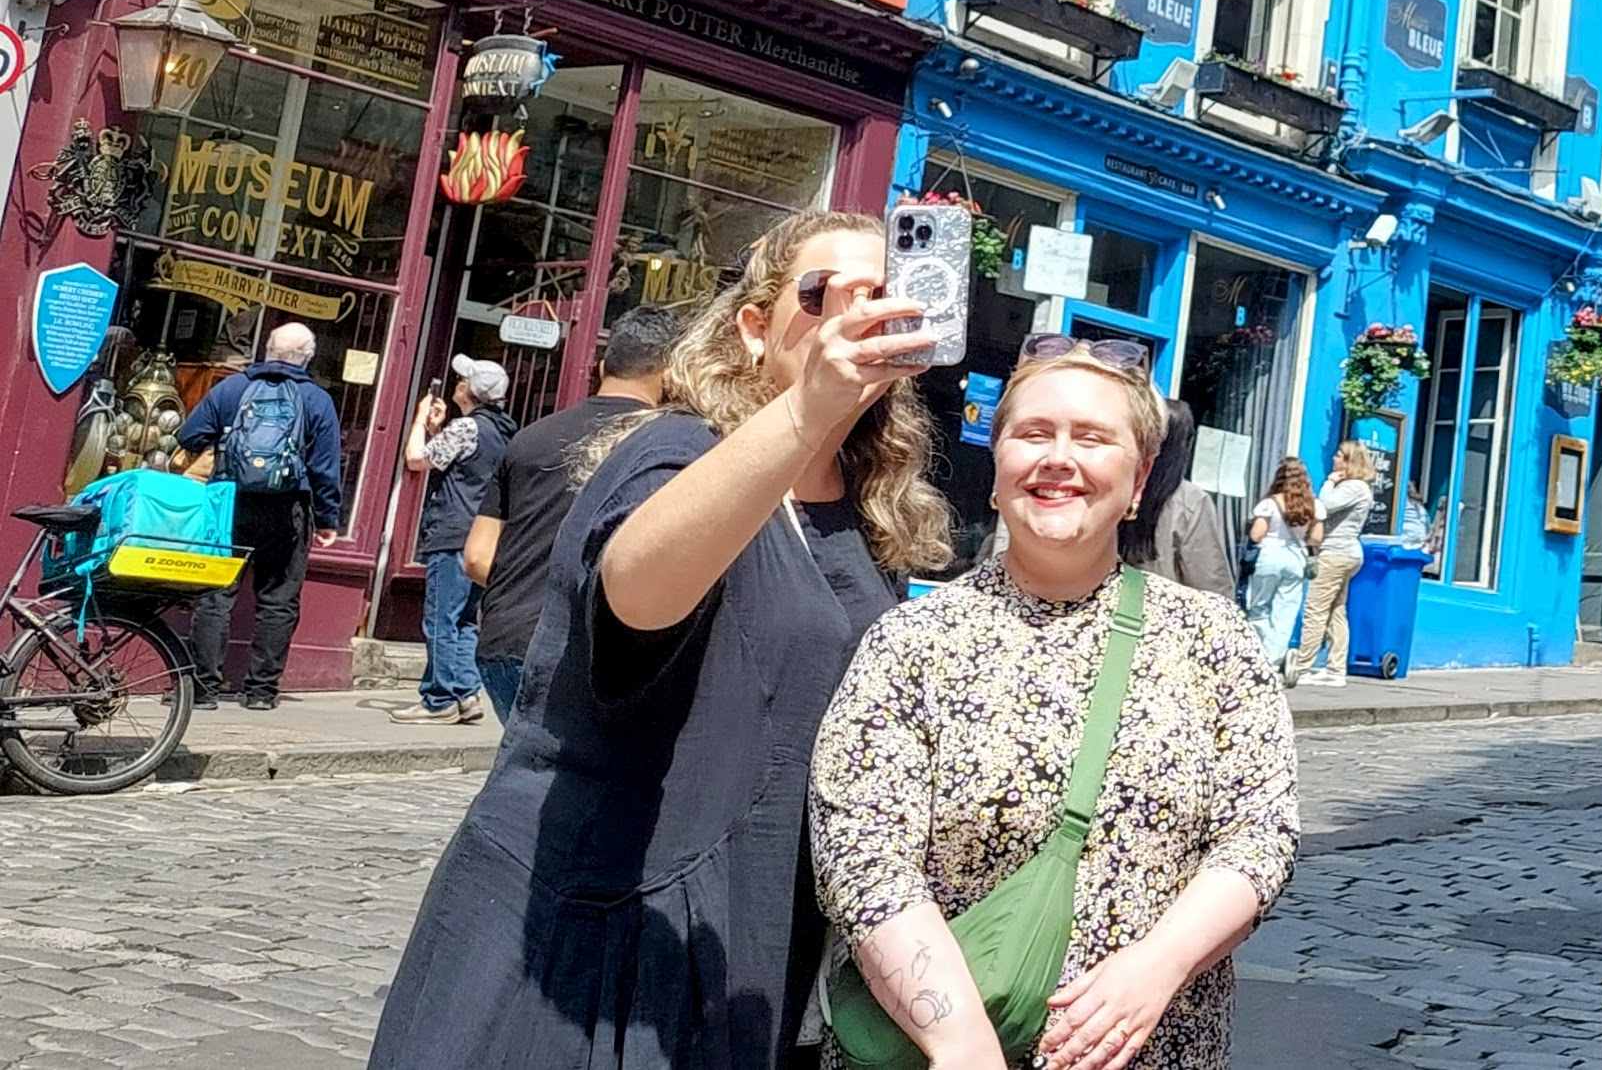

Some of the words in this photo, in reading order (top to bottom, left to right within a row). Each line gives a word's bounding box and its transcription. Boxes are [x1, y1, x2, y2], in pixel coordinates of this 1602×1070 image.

[321, 14, 367, 37] HARRY
[374, 30, 427, 56] POTTER
[348, 37, 366, 52] the
[653, 0, 745, 48] POTTER
[752, 31, 862, 85] Merchandise
[1408, 28, 1445, 60] BLEUE
[167, 53, 208, 89] 40
[171, 134, 375, 239] MUSEUM
[201, 206, 327, 260] CONEXT
[331, 242, 354, 268] 1840
[213, 269, 252, 295] HARRY
[643, 256, 722, 305] MUS
